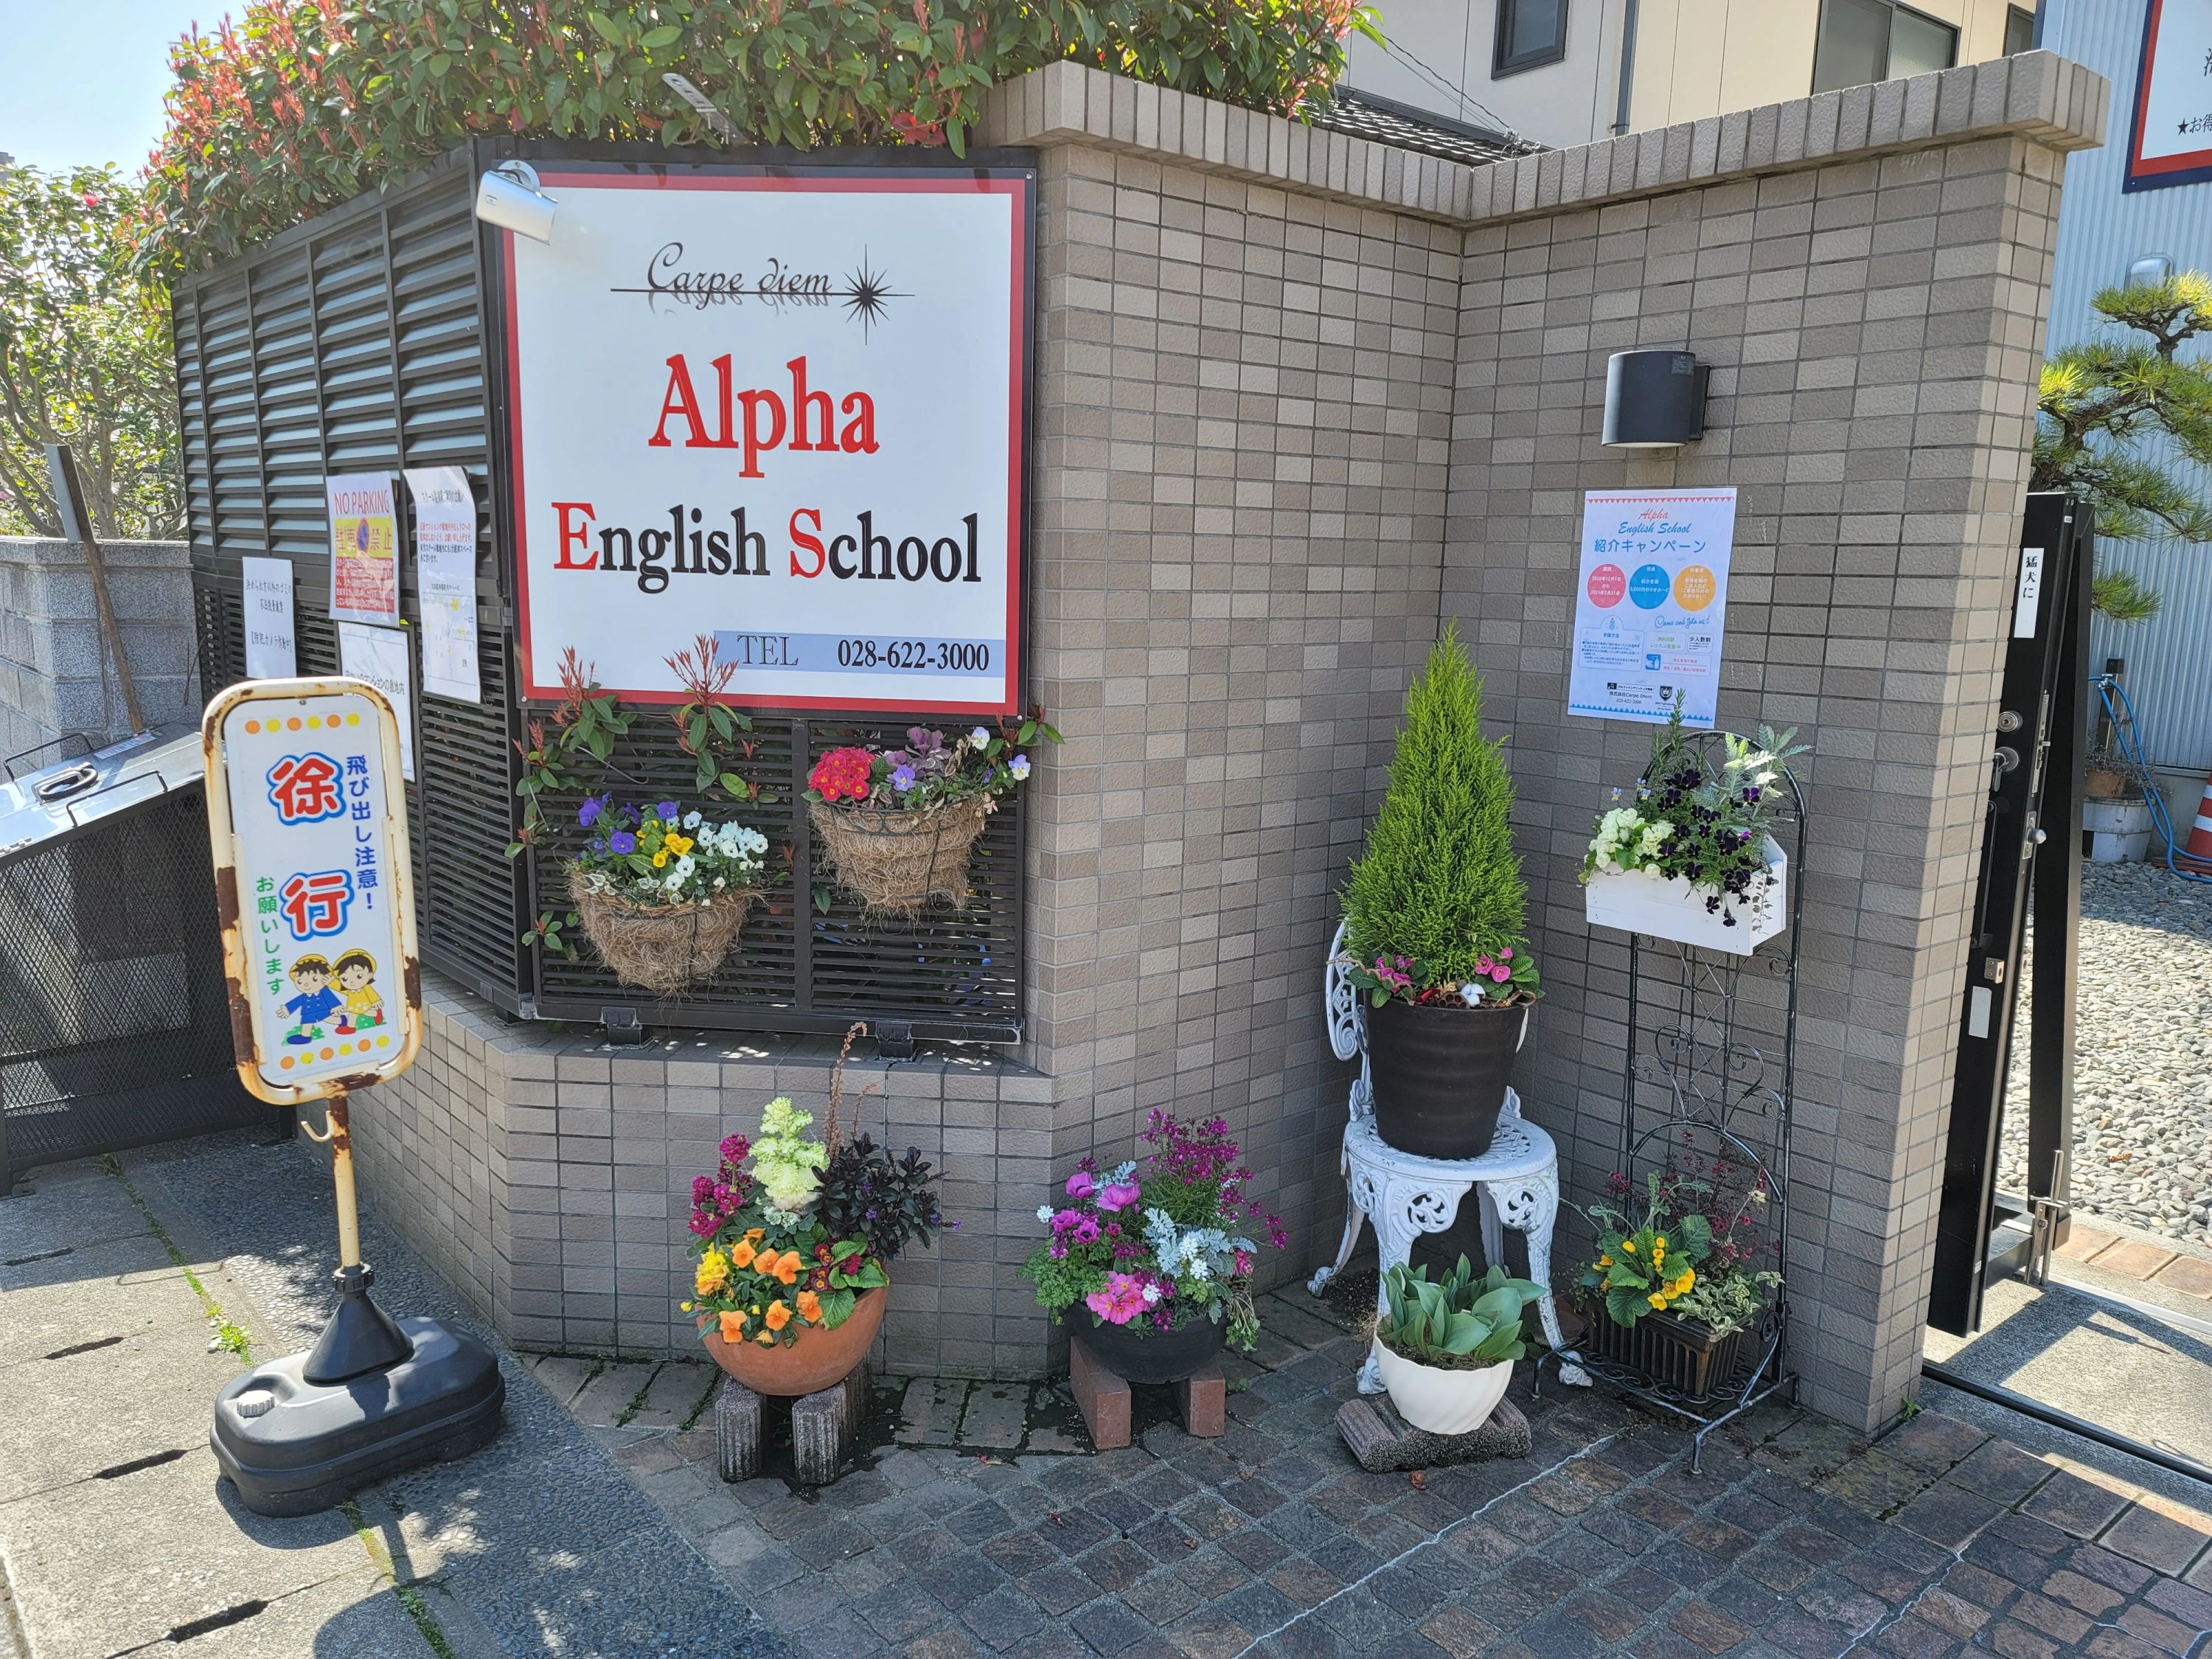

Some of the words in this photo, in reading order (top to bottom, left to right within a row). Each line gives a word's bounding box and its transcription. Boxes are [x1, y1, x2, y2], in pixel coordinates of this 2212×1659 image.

[647, 243, 745, 309] Carpe
[757, 257, 832, 293] diem
[647, 353, 880, 478] Alpha
[334, 492, 350, 515] NO
[352, 490, 389, 514] PARKING
[1638, 508, 1670, 521] Alpha
[371, 526, 392, 550] 禁止
[551, 501, 770, 594] English
[790, 508, 982, 582] School
[1594, 539, 1706, 553] 紹介キャンペーン
[1618, 521, 1655, 537] English
[1658, 522, 1692, 534] School
[2023, 556, 2038, 599] 猛犬に
[737, 635, 799, 667] TEL
[838, 639, 990, 672] 028-622-3000
[268, 753, 354, 941] 徐行
[347, 755, 378, 911] 飛び出し注意！
[256, 876, 285, 995] お願いします
